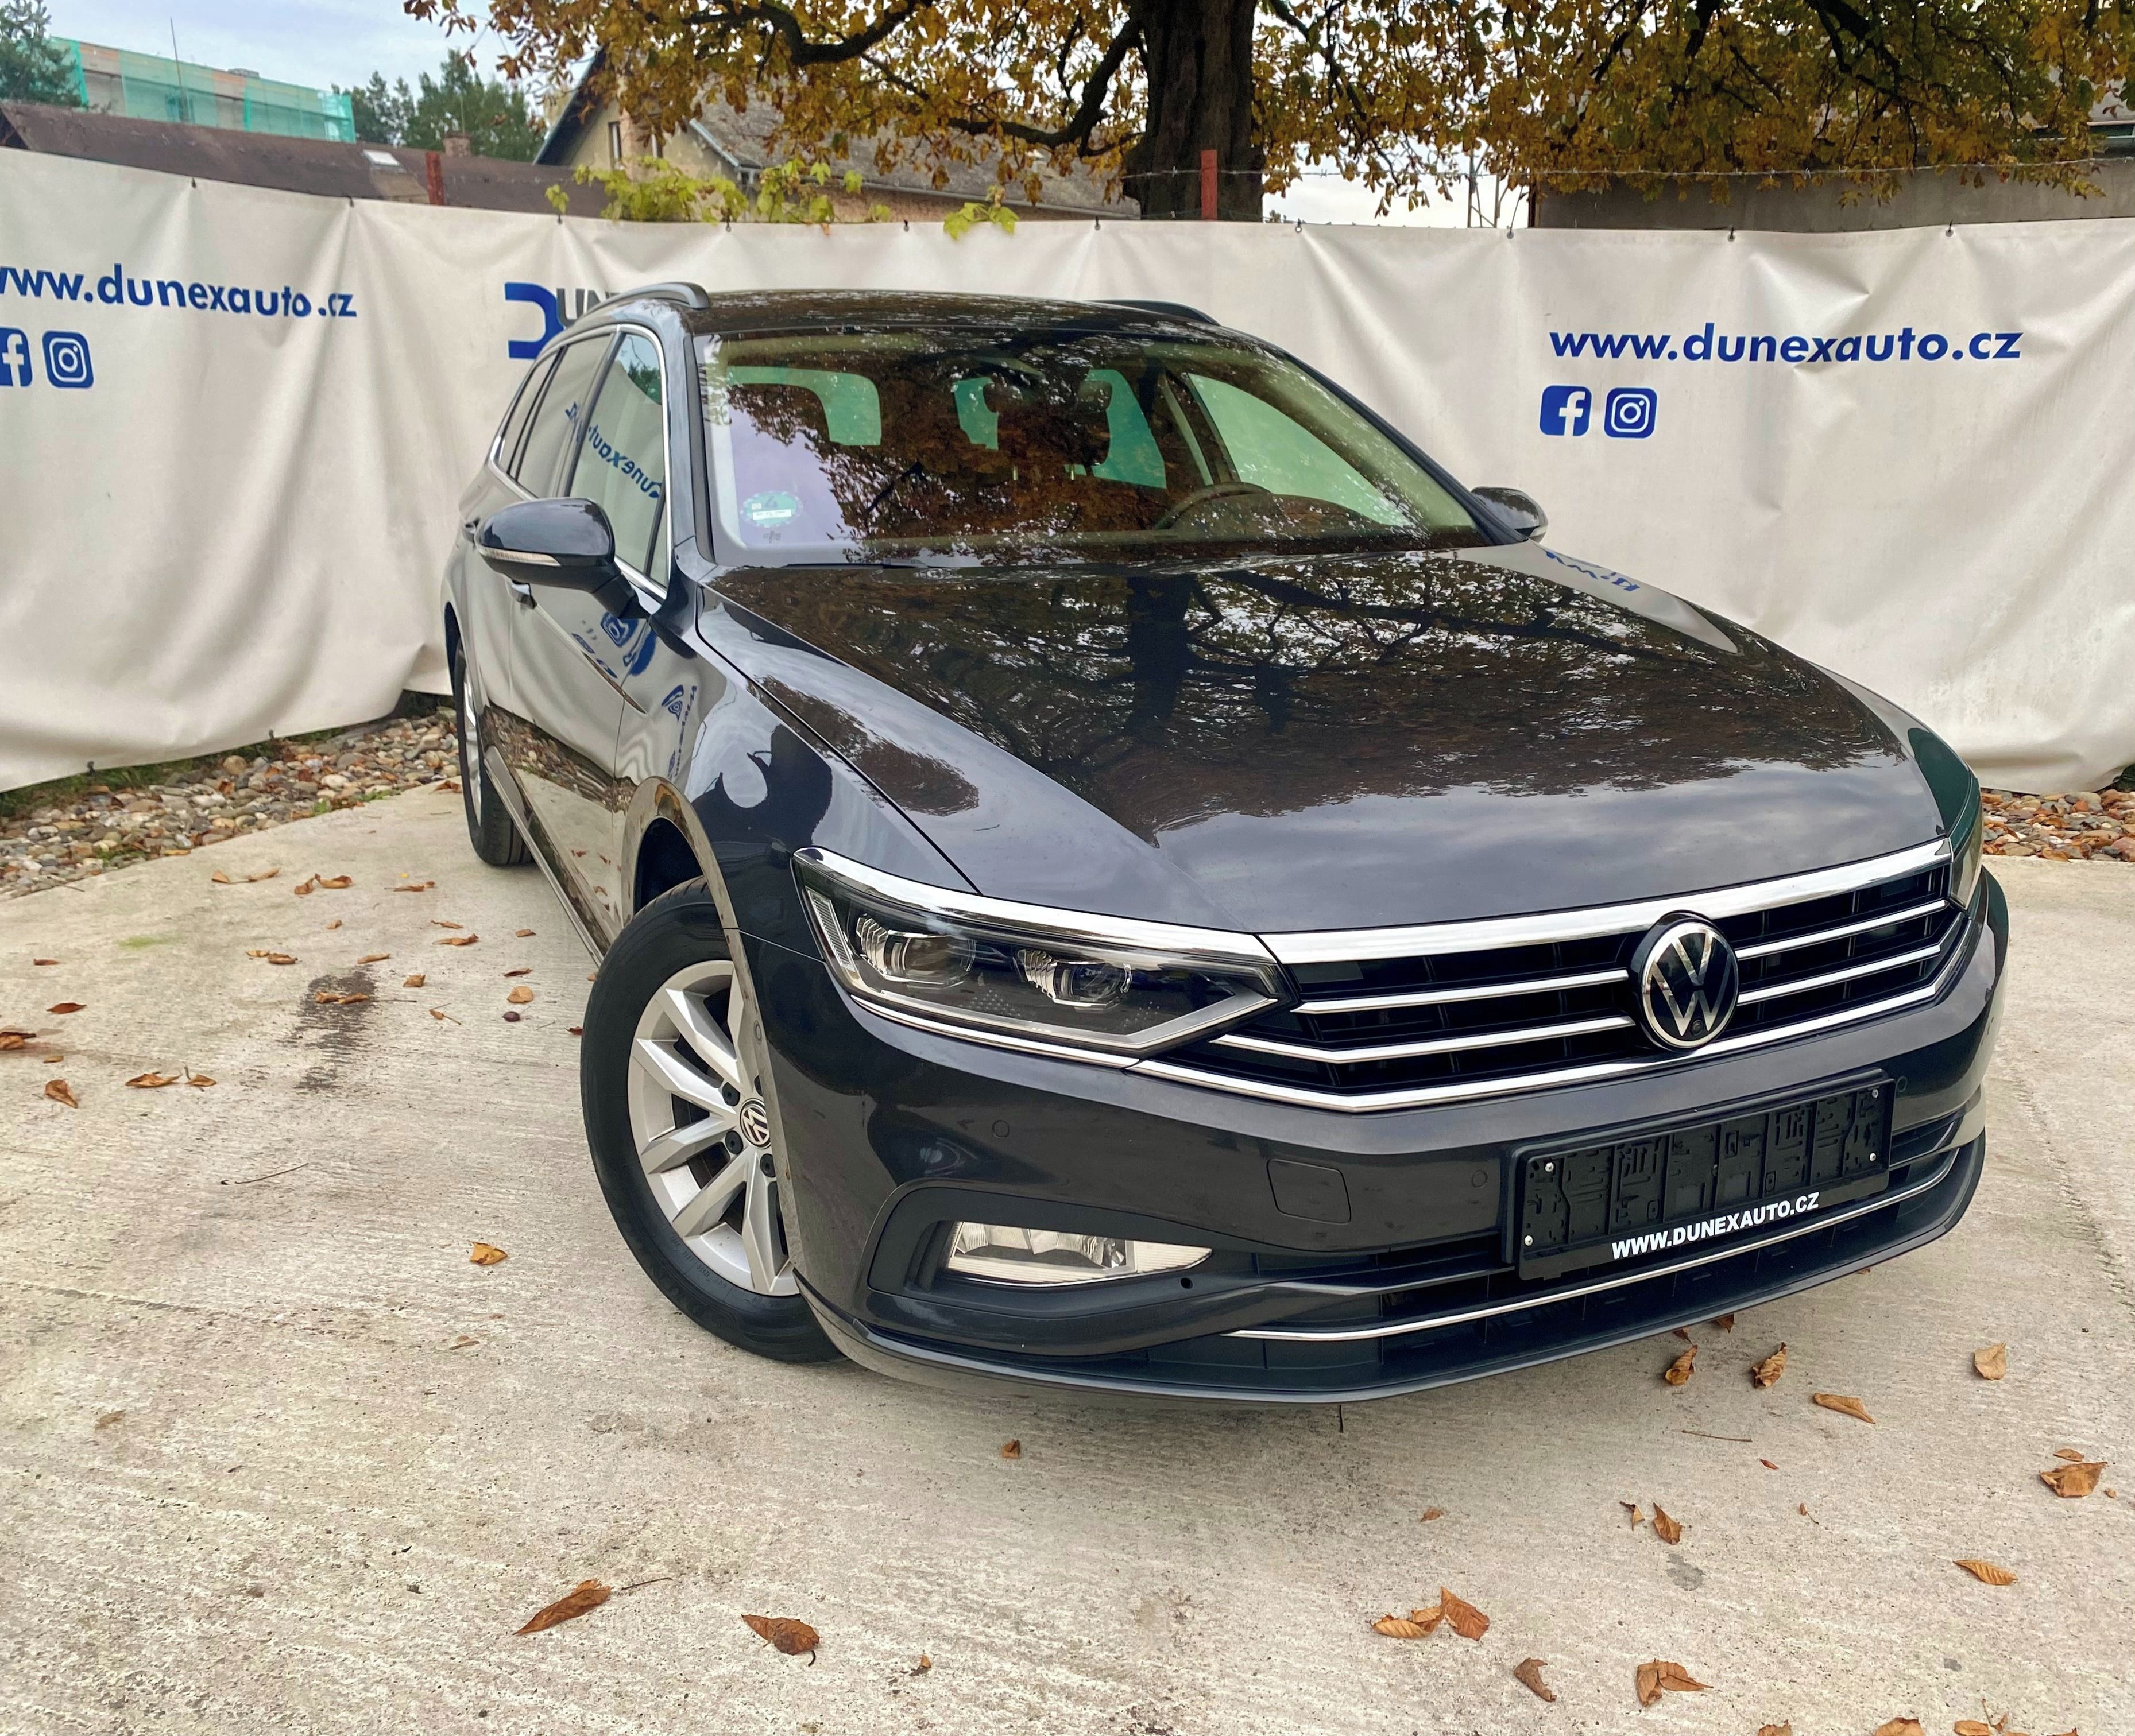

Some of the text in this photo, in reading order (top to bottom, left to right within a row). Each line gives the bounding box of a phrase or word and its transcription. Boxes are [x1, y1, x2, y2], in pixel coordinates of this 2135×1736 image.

[0, 263, 357, 317] ww.dunexauto.cz
[1549, 322, 2024, 362] www.dunexauto.cz
[1611, 1191, 1820, 1260] WWW.DUNEXAUTO.CZ
